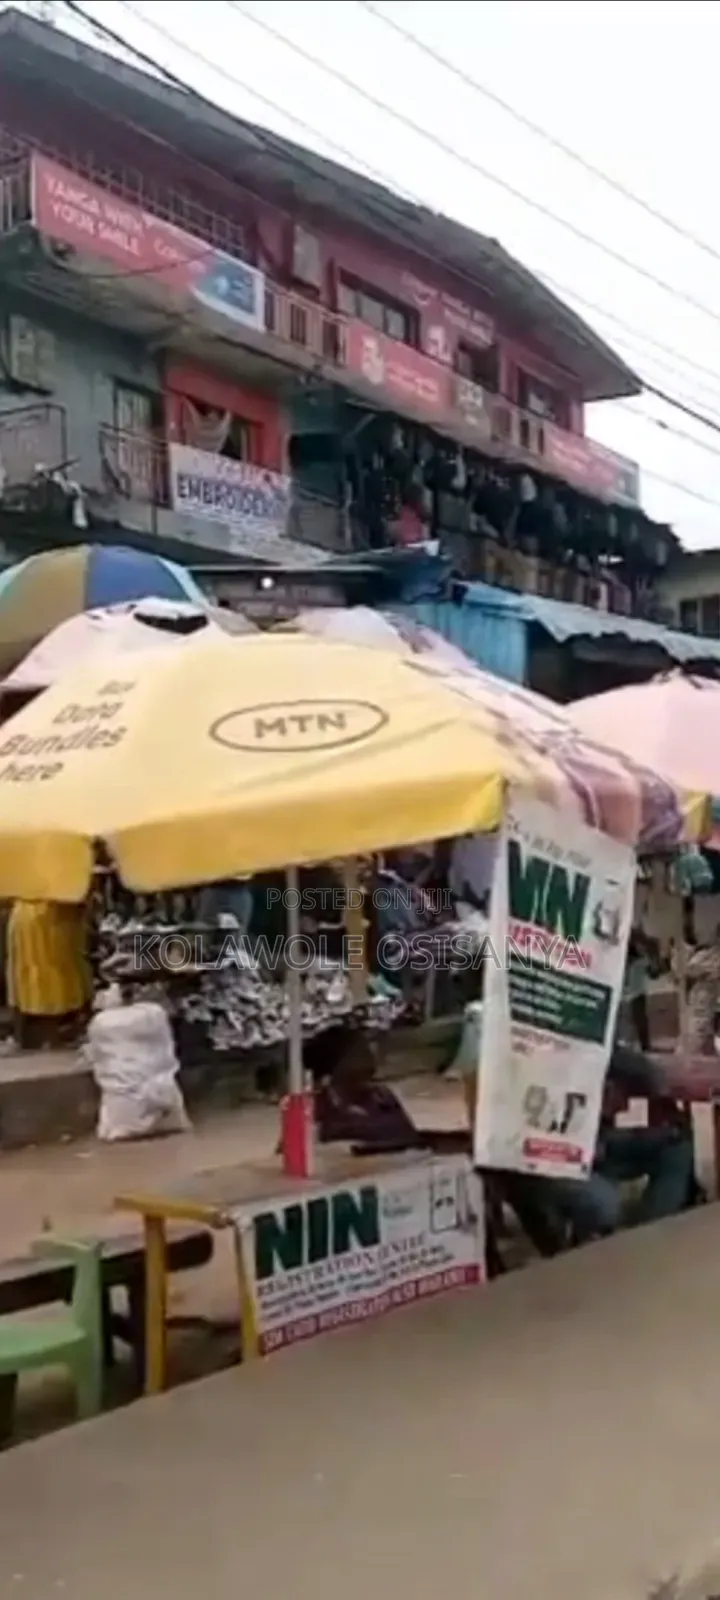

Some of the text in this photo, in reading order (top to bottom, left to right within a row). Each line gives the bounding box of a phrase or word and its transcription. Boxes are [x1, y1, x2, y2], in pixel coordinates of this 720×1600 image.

[51, 202, 96, 236] YOUR
[52, 702, 124, 724] Data
[254, 711, 348, 740] MTN
[0, 725, 128, 759] Bundles
[0, 760, 65, 782] here
[253, 1185, 382, 1279] NIN
